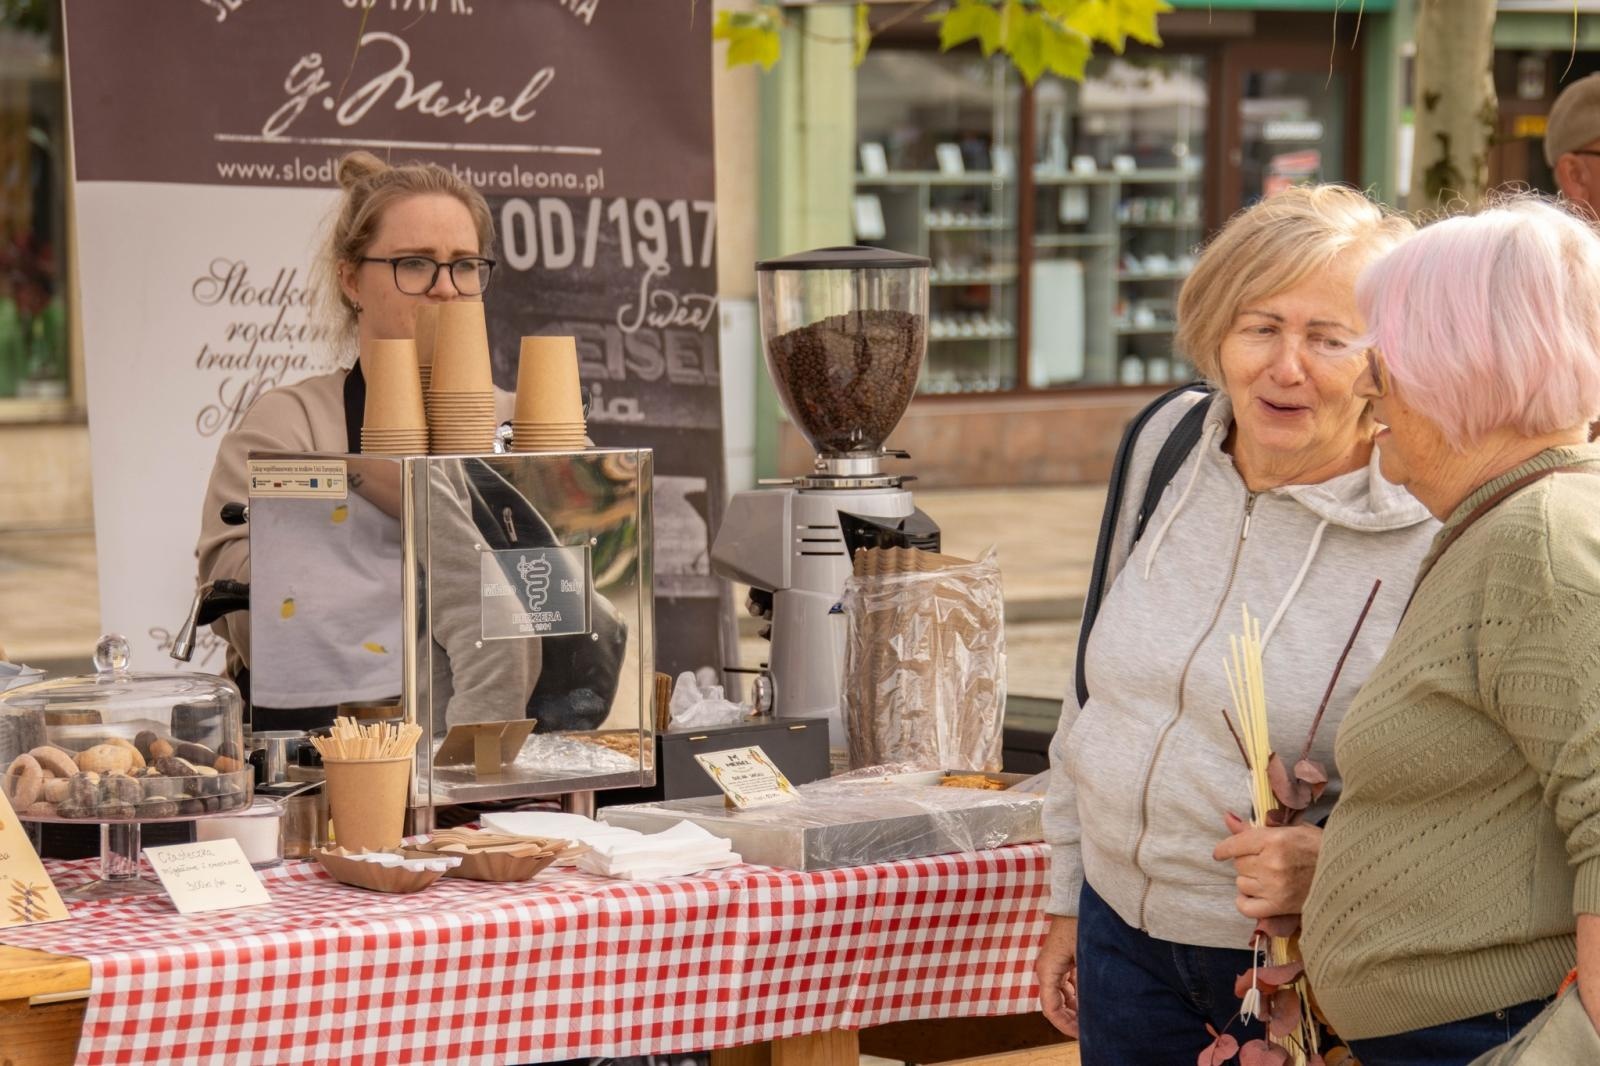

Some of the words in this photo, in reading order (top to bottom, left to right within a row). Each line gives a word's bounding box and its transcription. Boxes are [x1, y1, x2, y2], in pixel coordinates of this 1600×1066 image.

[336, 31, 555, 126] Meisel
[217, 157, 604, 194] www.slodkturaleona.pl
[501, 197, 716, 271] OD/1917
[226, 304, 330, 349] rodzin
[616, 258, 718, 333] Sweet
[562, 321, 720, 386] EISEL
